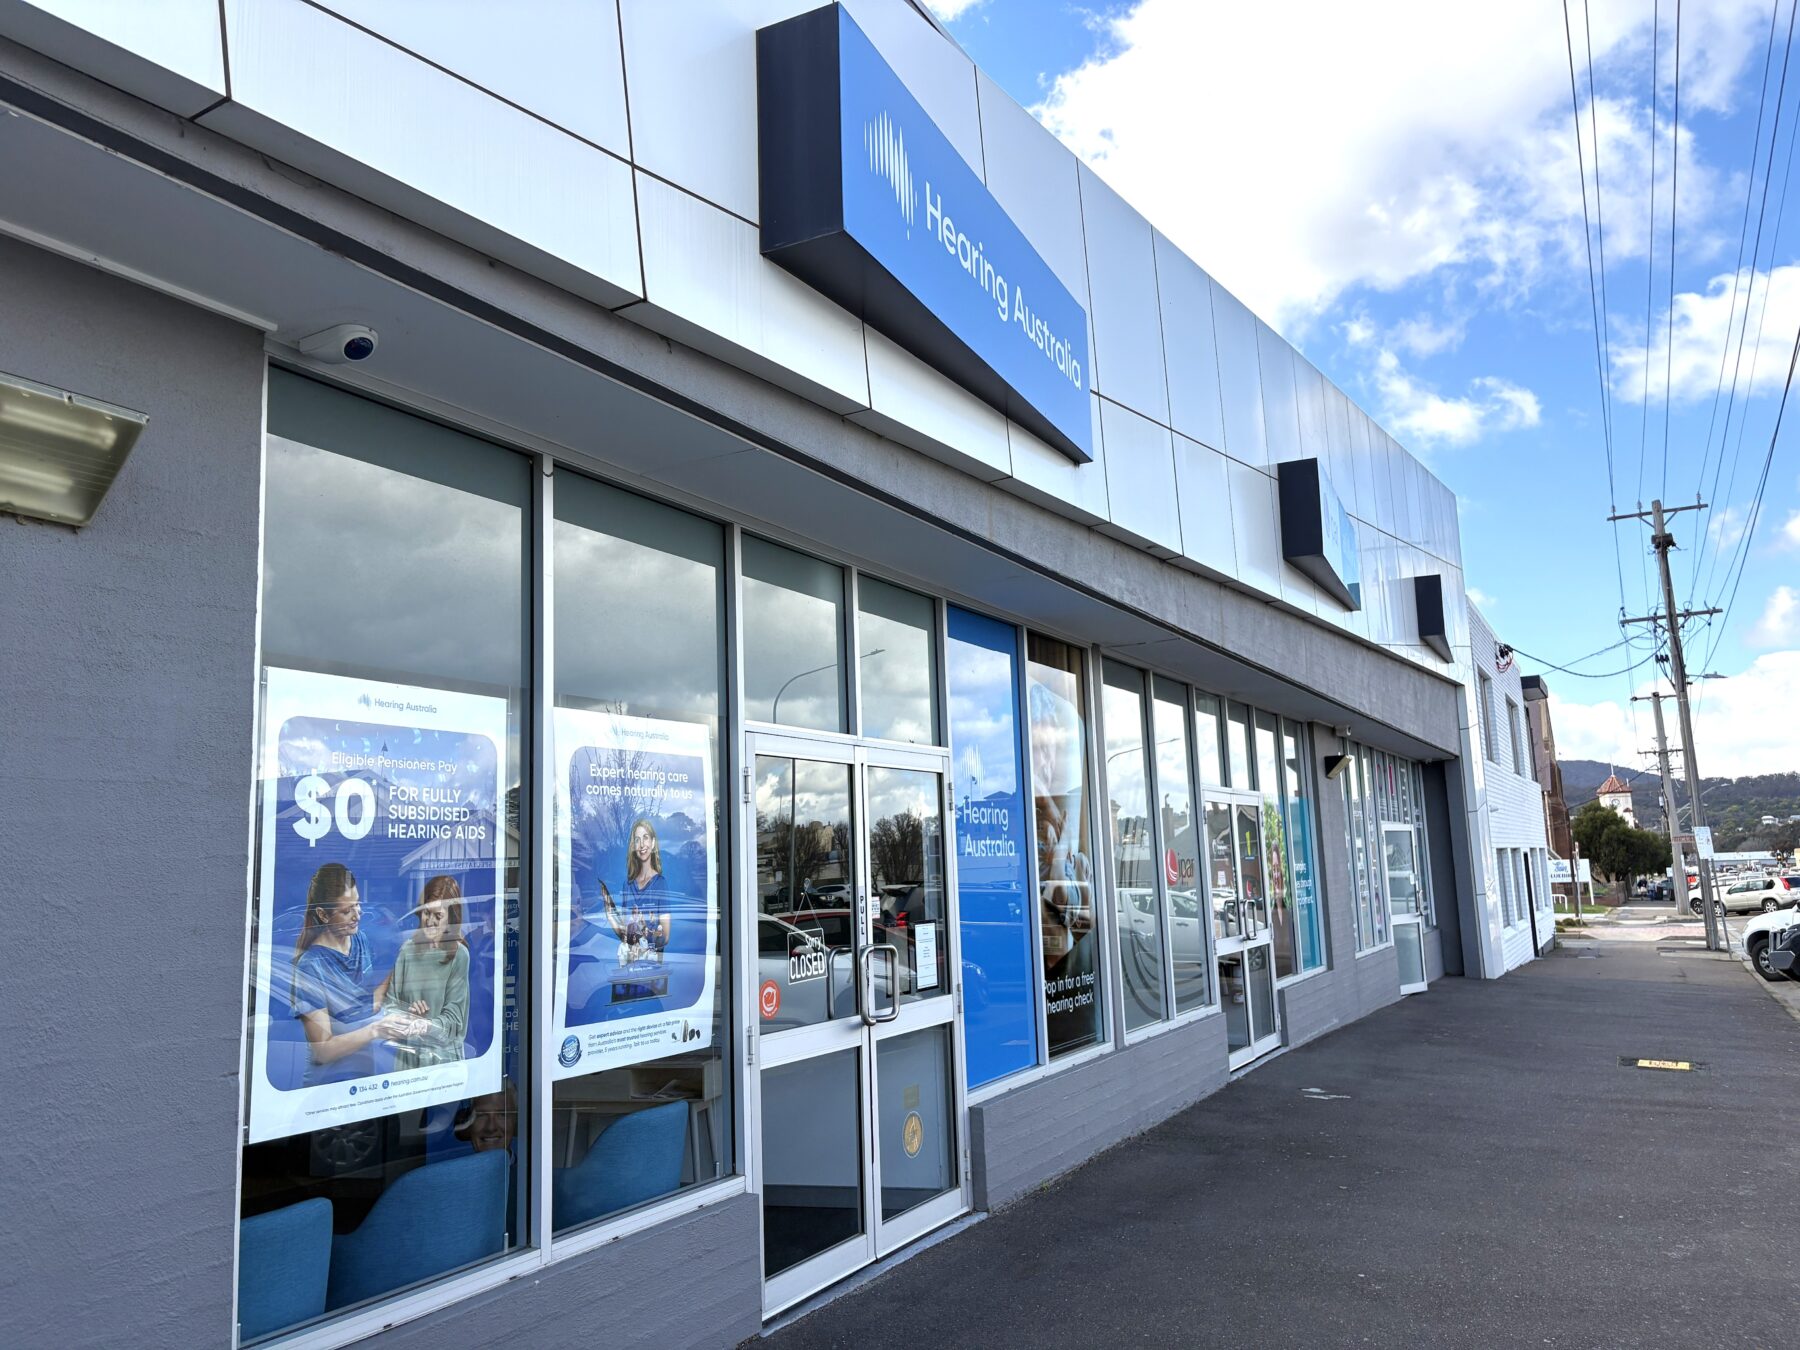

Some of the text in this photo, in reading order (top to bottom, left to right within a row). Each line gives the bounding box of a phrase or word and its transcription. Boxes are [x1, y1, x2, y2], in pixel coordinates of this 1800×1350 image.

[926, 180, 1082, 390] Hearing Australia
[374, 698, 438, 714] Hearing Australia
[332, 752, 458, 774] Eligible Pensioners Pay
[590, 764, 688, 783] Expert hearing care
[389, 786, 462, 803] FOR FULLY
[586, 784, 693, 799] comes naturally to us
[388, 804, 470, 822] SUBSIDISED
[963, 799, 1008, 831] Hearing
[388, 824, 486, 840] HEARING AIDS
[965, 833, 1015, 857] Australia
[1178, 852, 1194, 886] ipar
[805, 935, 822, 950] Sorry
[790, 952, 825, 980] CLOSED
[1057, 976, 1064, 992] in
[1065, 974, 1074, 990] for
[1076, 976, 1081, 987] a
[1047, 989, 1094, 1014] hearing check
